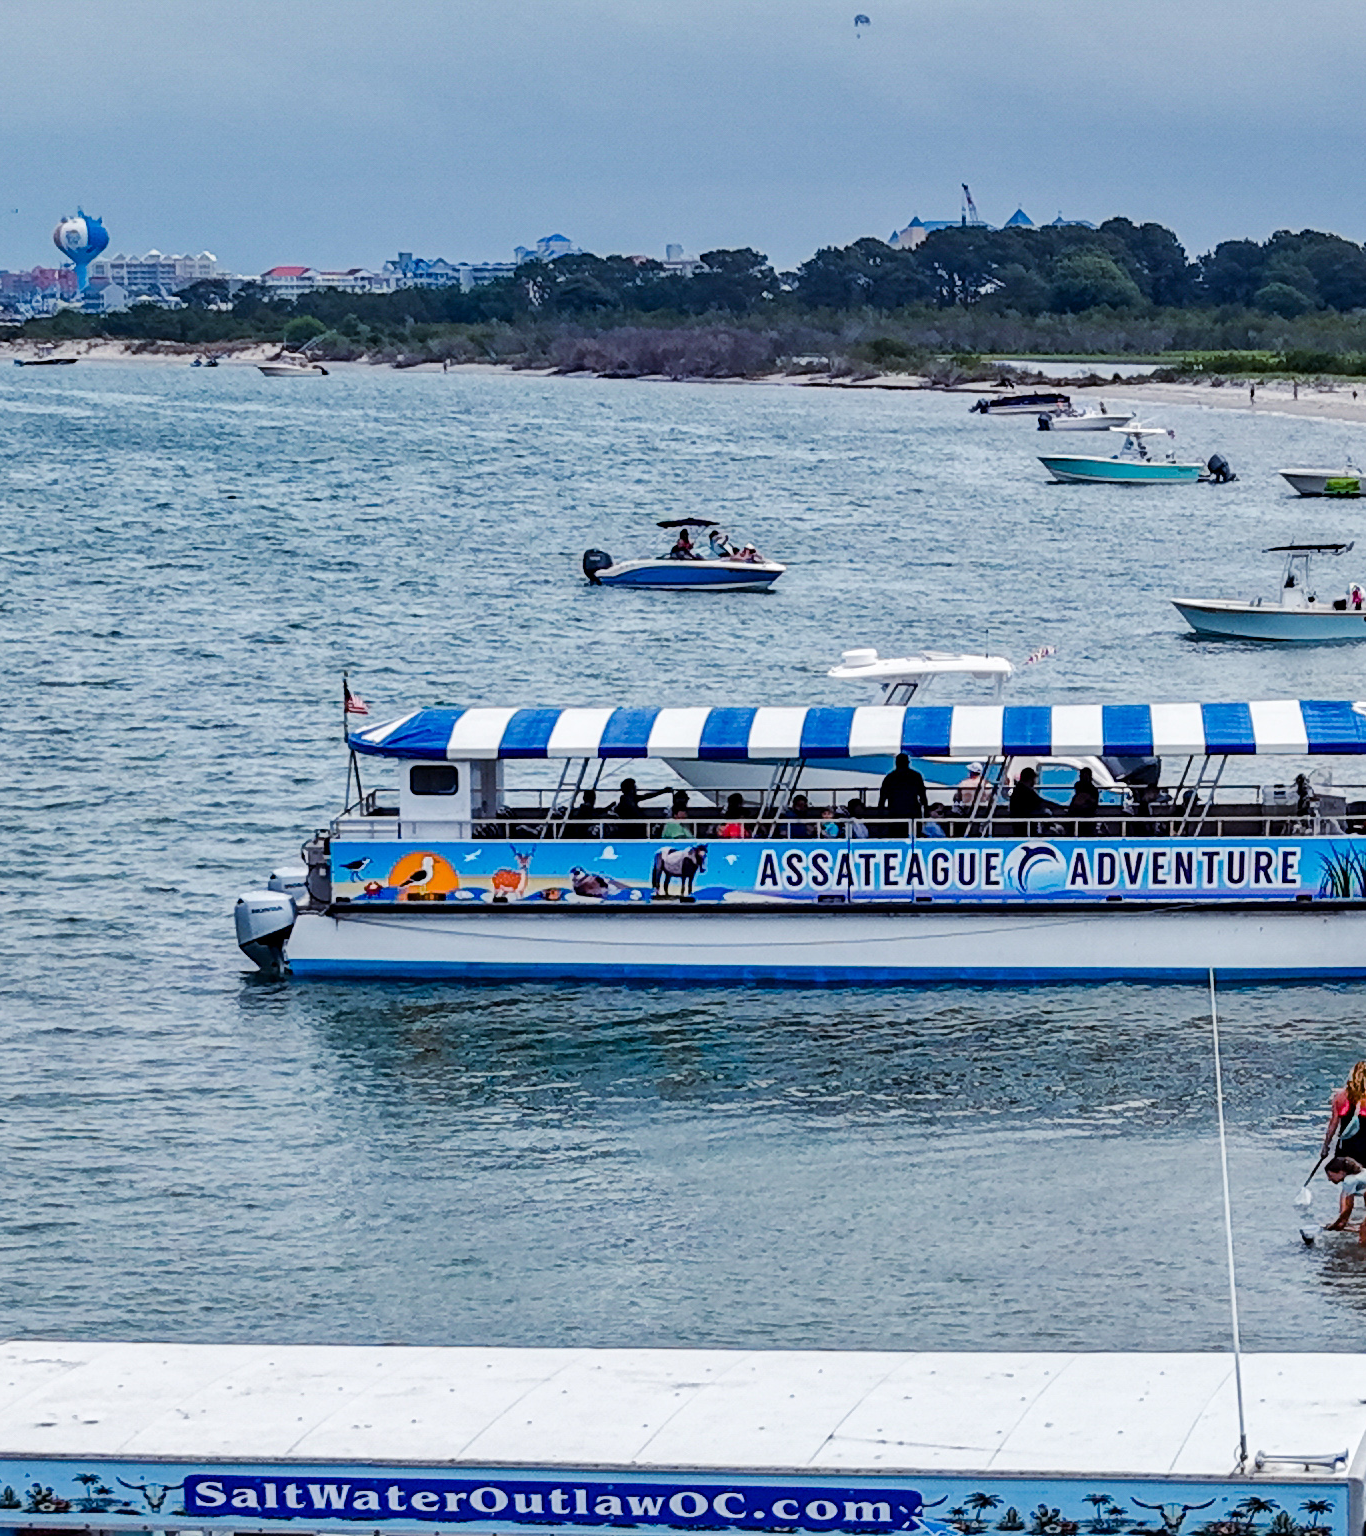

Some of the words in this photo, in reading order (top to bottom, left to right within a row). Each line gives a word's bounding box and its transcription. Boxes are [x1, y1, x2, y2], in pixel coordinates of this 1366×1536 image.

[759, 851, 1001, 887] ASSATEAGUE
[1068, 850, 1299, 886] ADVENTURE
[195, 1481, 893, 1522] SaltWaterOutlawOC.com
